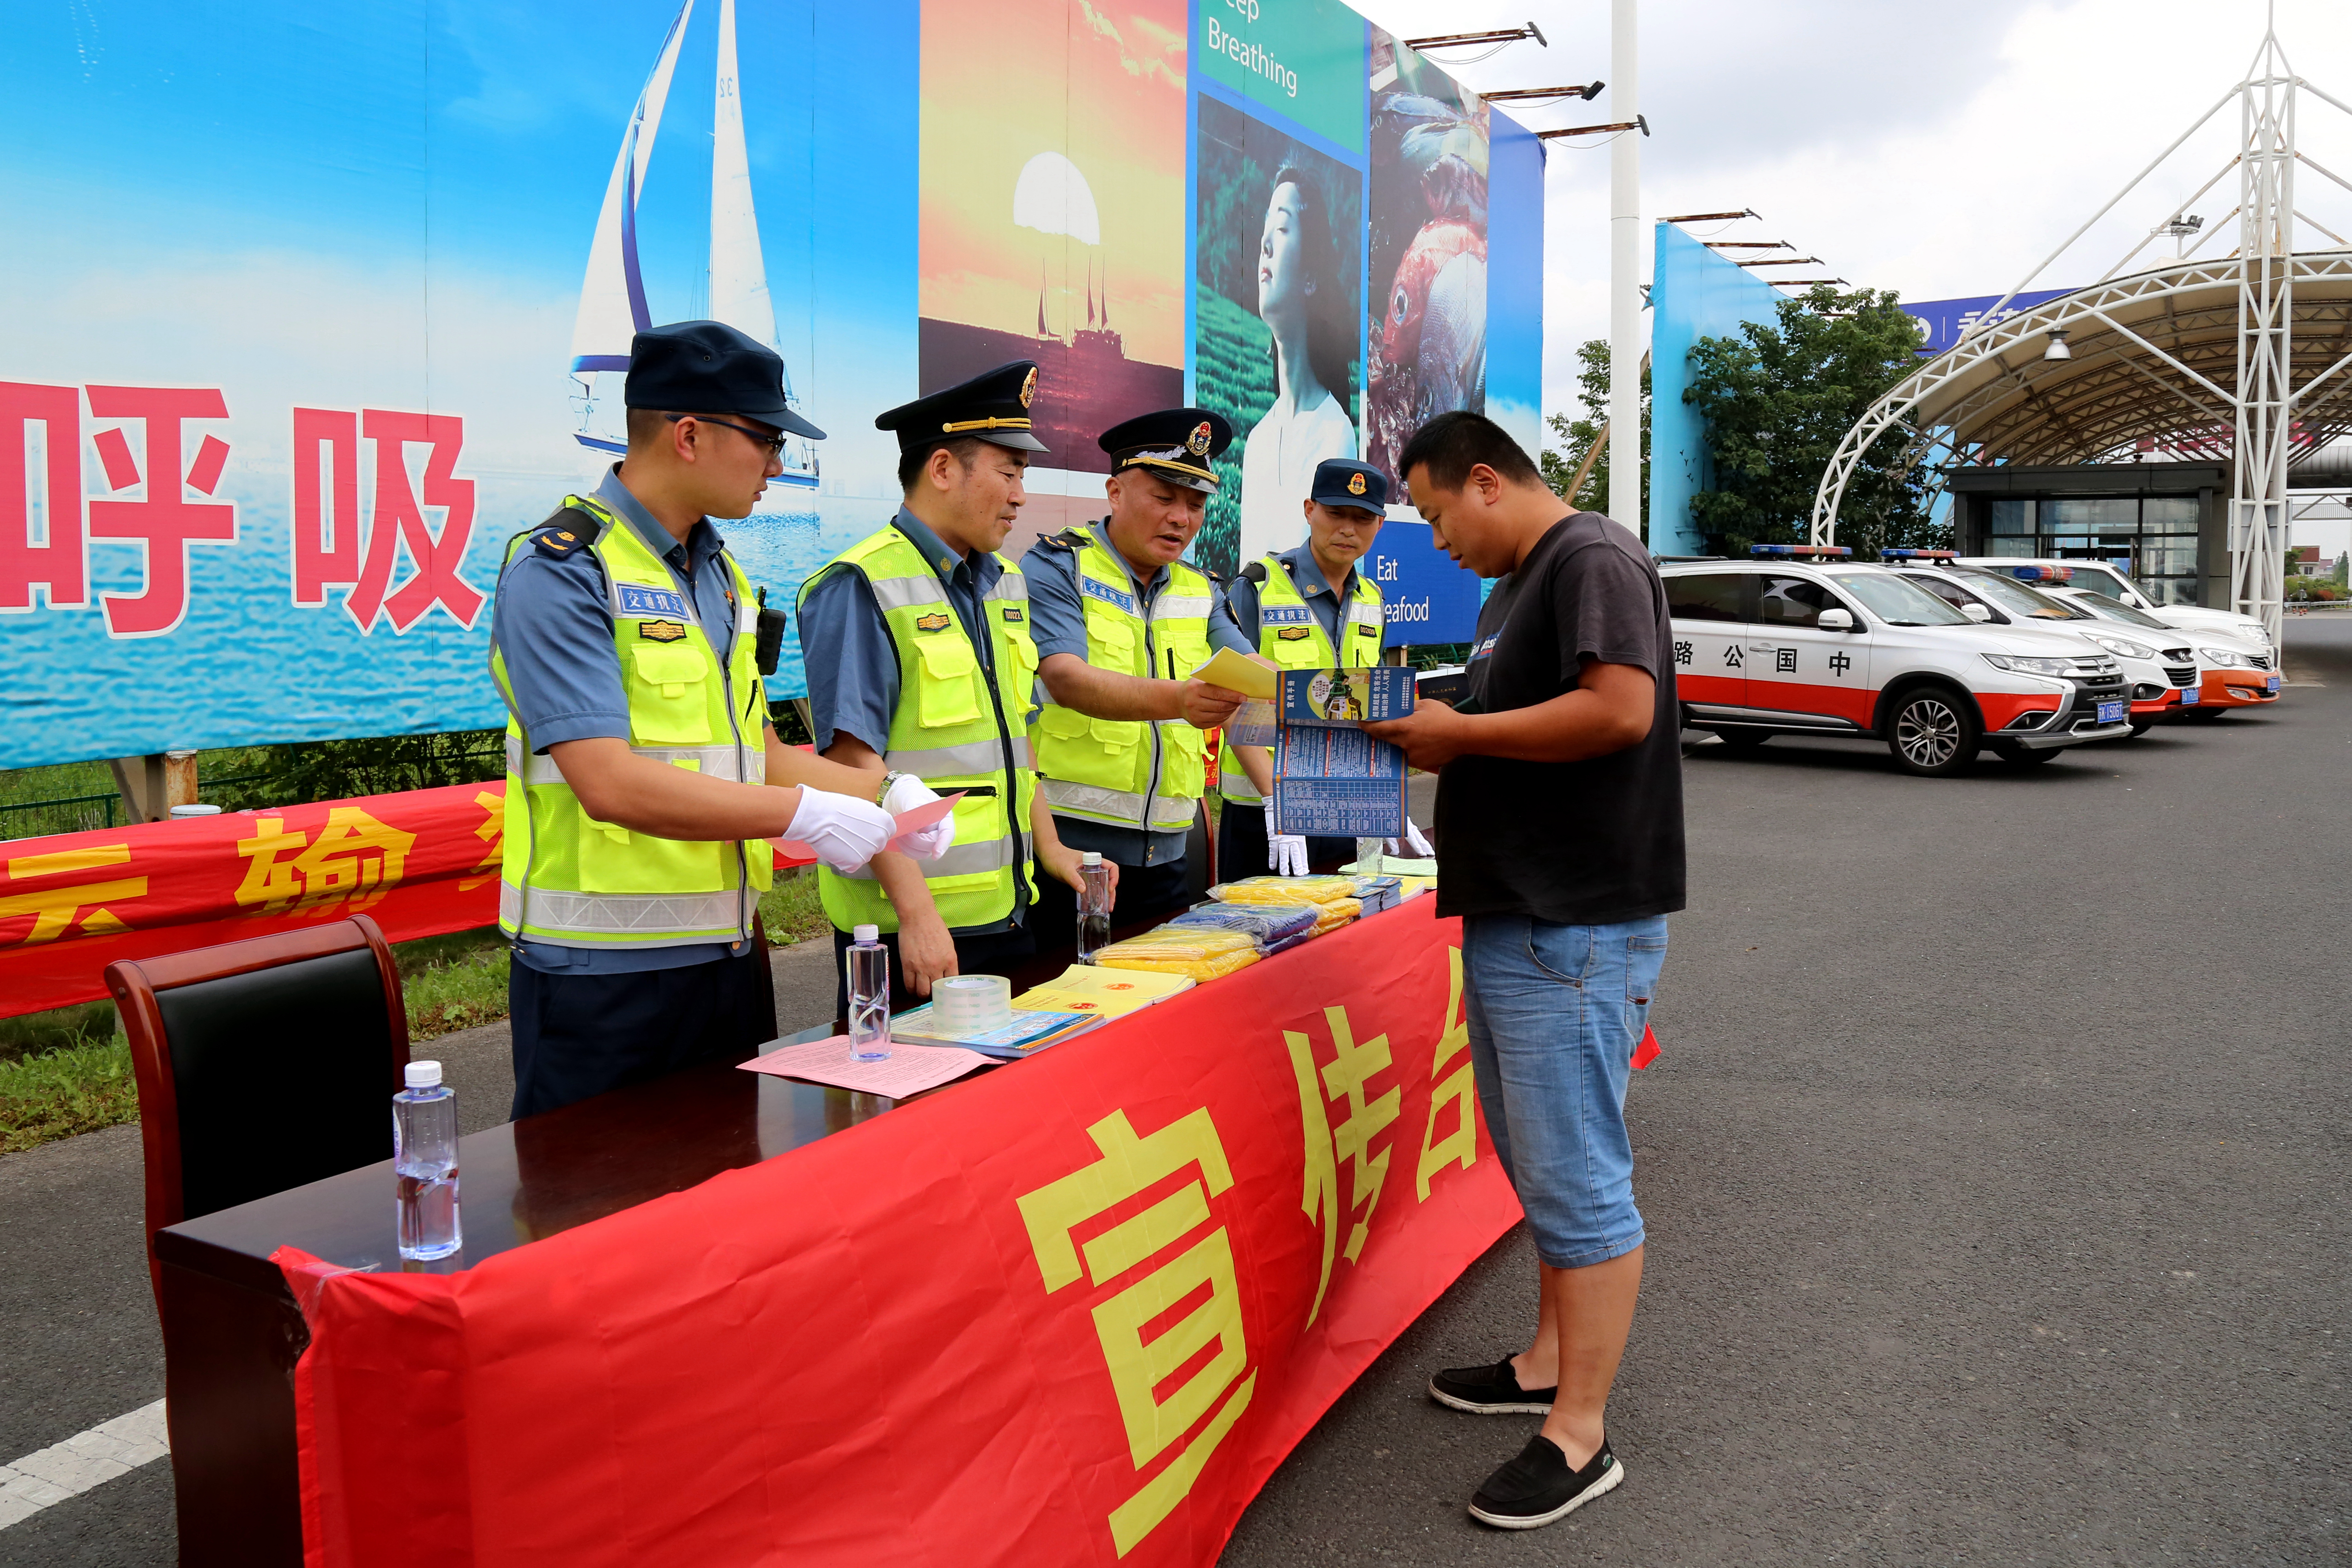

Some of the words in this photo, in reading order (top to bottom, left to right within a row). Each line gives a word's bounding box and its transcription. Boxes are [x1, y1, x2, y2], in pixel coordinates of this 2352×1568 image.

[1209, 16, 1296, 97] Breathing
[0, 379, 487, 639] 呼吸
[1377, 555, 1398, 581] Eat
[627, 590, 682, 613] 交通执法
[1089, 582, 1127, 608] 交通执法
[1266, 610, 1306, 621] 交通执法
[1382, 669, 1391, 692] 人人有责
[1287, 680, 1295, 708] 宣传手册
[1380, 693, 1389, 718] 治超治限
